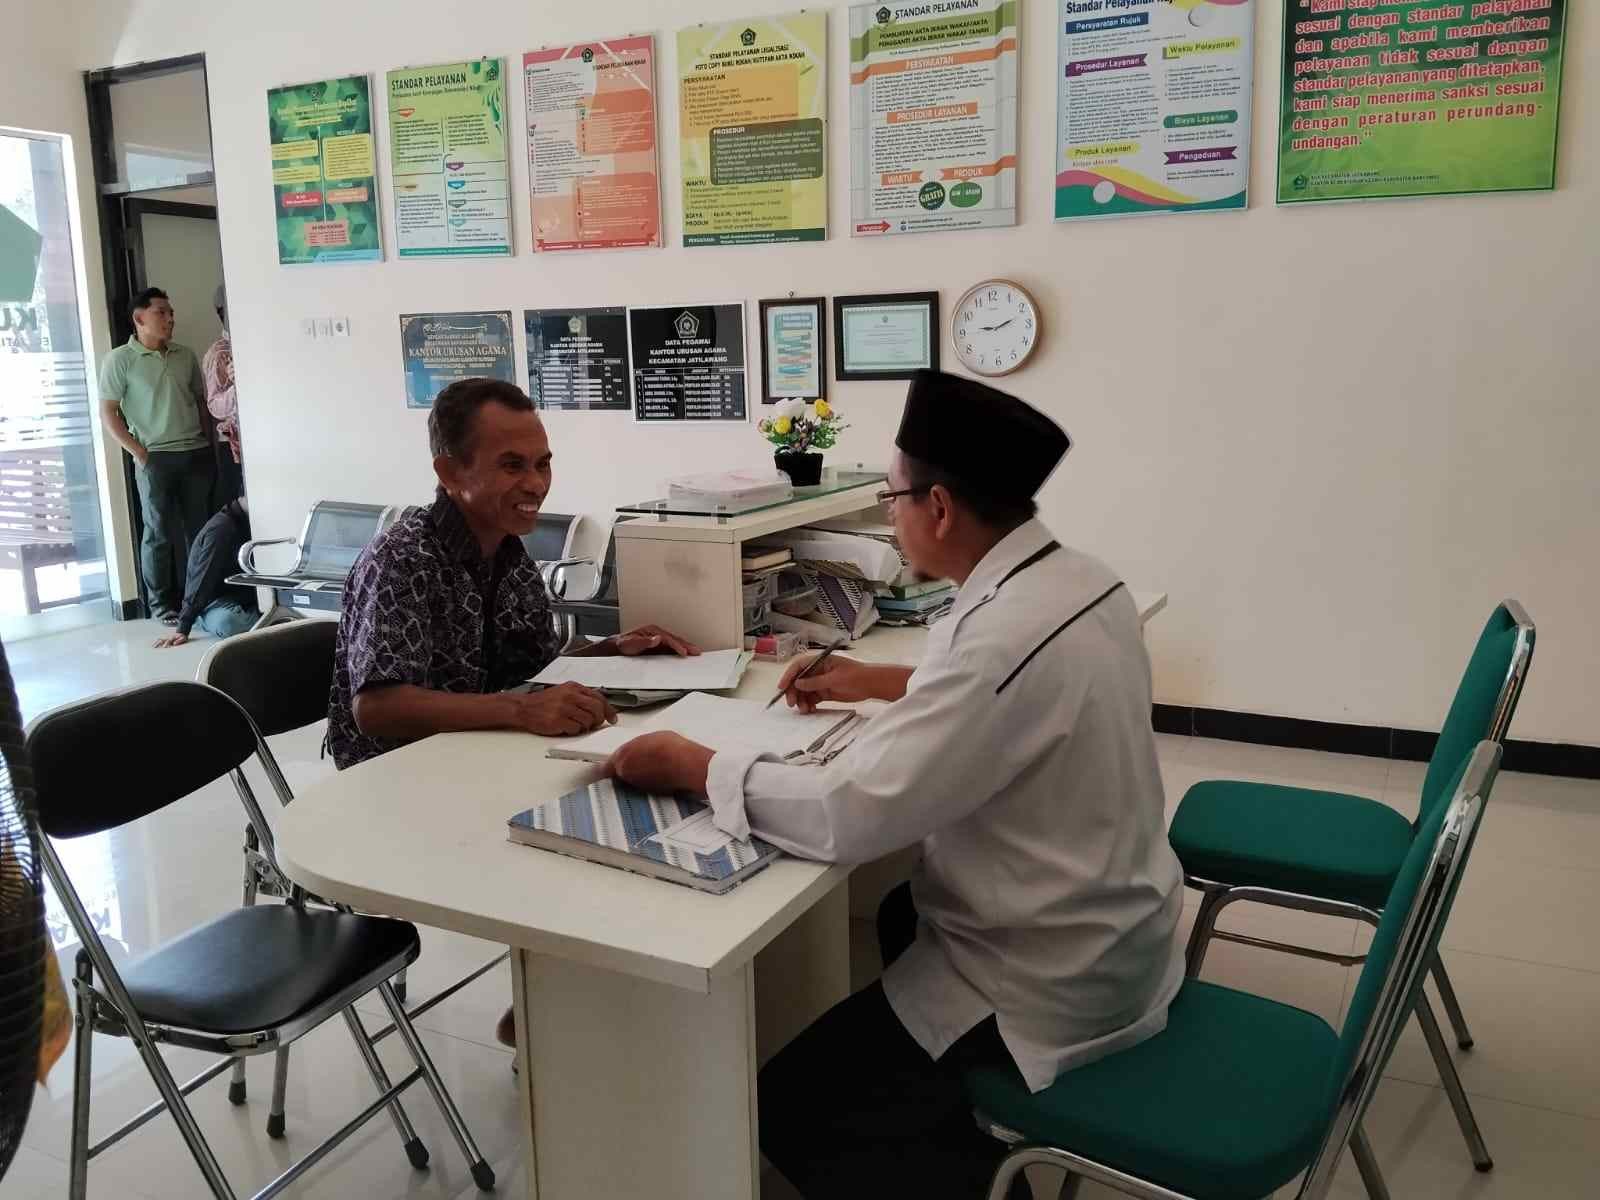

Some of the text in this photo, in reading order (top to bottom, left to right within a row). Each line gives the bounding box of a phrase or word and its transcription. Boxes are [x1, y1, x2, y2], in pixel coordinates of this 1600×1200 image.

[895, 0, 979, 19] STANDAR PELAYANAN
[1066, 0, 1102, 14] Standar
[1075, 16, 1141, 31] Persyaratan Rujuk
[1296, 0, 1551, 34] sesuai dengan standar pelayanan
[1296, 17, 1549, 53] dan apabila kami memberikan
[1295, 38, 1548, 74] pelayanan tidak sesuai dengan
[392, 73, 466, 91] STANDAR PELAYANAN
[1295, 75, 1345, 92] standar
[1348, 70, 1419, 89] pelayanan
[1422, 67, 1456, 83] yang
[1294, 80, 1544, 111] kami siap menerima sanksi sesuai
[1293, 102, 1542, 131] dengan peraturan perundang-
[676, 347, 702, 355] URUSAN
[704, 346, 727, 354] AGAMA
[682, 338, 711, 346] PEGAWAI
[408, 348, 441, 358] KANTOR
[476, 345, 507, 356] AGAMA
[688, 356, 728, 364] JATILAWANG
